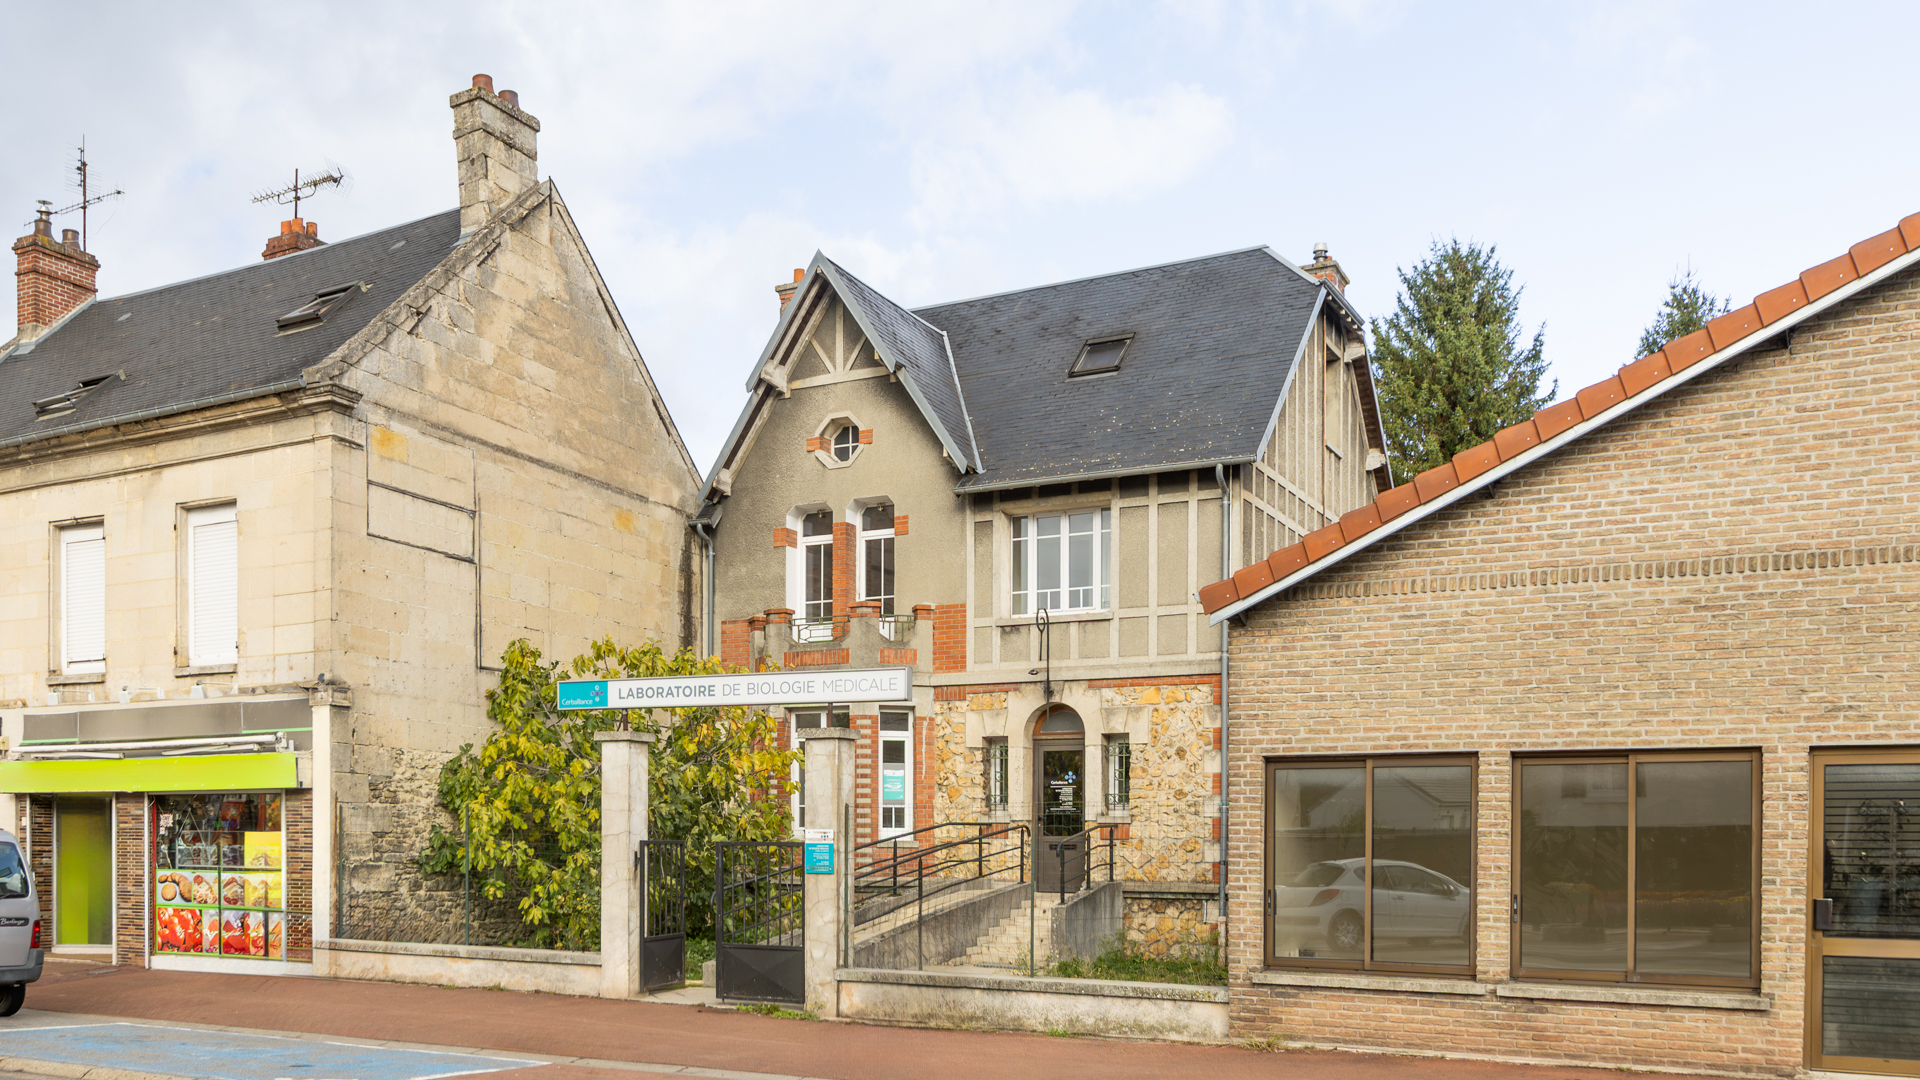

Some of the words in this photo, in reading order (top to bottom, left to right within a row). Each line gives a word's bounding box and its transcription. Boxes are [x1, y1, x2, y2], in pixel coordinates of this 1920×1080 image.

[618, 684, 716, 700] LABORATOIRE
[722, 683, 741, 697] DE
[747, 680, 815, 696] BIOLOGIE
[822, 677, 898, 693] MÉDICALE
[561, 698, 593, 706] Cerballiance
[0, 917, 25, 926] Berlingo
